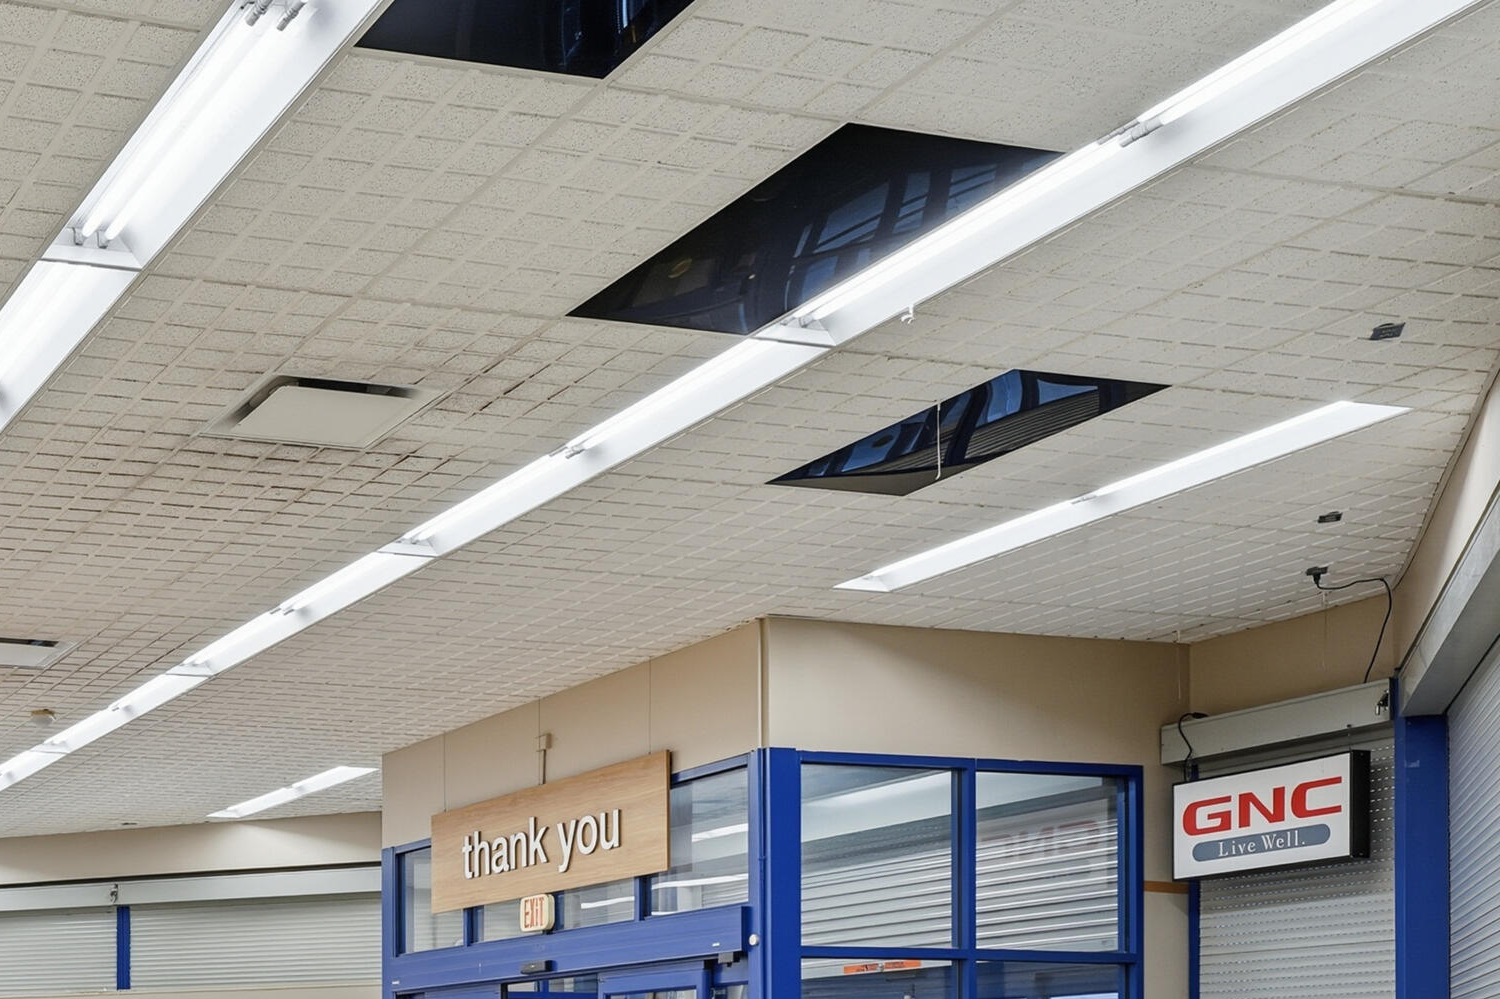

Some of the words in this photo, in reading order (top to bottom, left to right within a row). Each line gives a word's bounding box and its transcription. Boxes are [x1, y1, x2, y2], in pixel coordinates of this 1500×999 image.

[1183, 776, 1342, 836] GNC
[462, 816, 549, 879] thank
[557, 808, 621, 873] you
[1218, 841, 1256, 857] Live
[1260, 830, 1306, 850] Well.
[524, 897, 545, 928] EXIT
